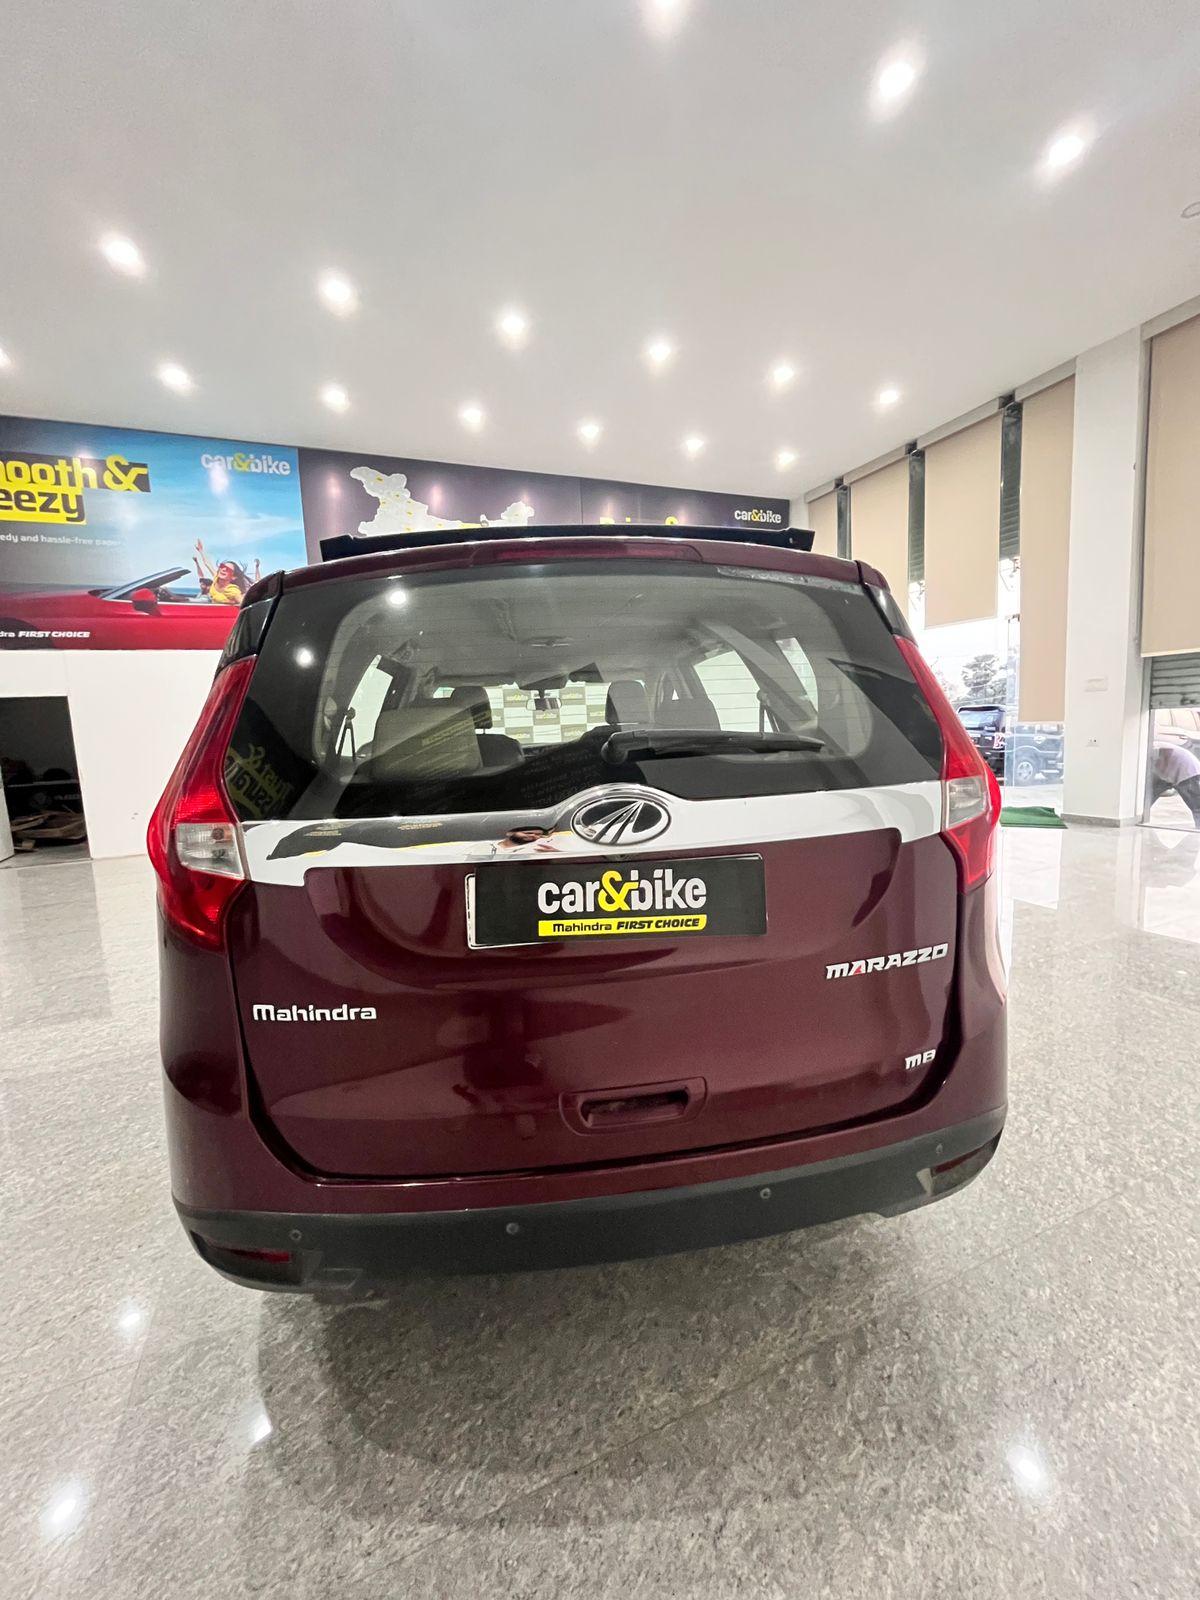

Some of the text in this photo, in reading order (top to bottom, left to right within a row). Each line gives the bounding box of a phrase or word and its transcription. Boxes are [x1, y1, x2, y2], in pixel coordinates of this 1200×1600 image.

[103, 455, 148, 492] &
[201, 453, 291, 475] car&bike
[734, 509, 782, 523] car&bike
[20, 534, 39, 542] and
[537, 869, 707, 914] car&bike
[553, 918, 700, 932] Mahindra FIRST CHOICE
[826, 943, 948, 979] MARAZZO
[252, 1004, 377, 1021] Mahindra
